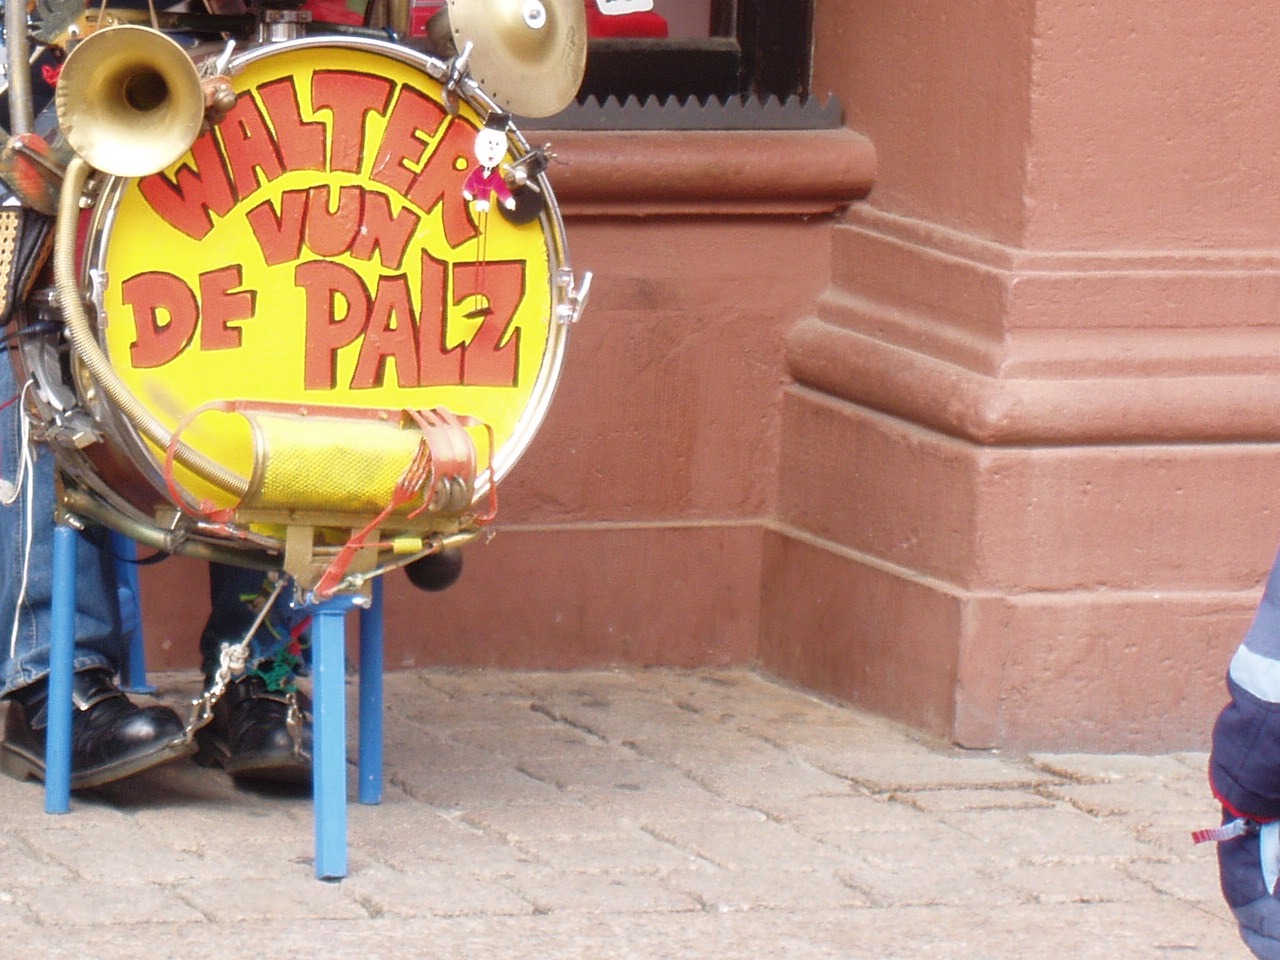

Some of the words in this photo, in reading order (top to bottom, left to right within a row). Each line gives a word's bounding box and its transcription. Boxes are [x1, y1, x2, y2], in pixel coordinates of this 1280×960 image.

[138, 69, 486, 246] WALTER
[246, 184, 420, 270] VUN
[122, 264, 257, 369] DE
[295, 248, 527, 390] PALZ
